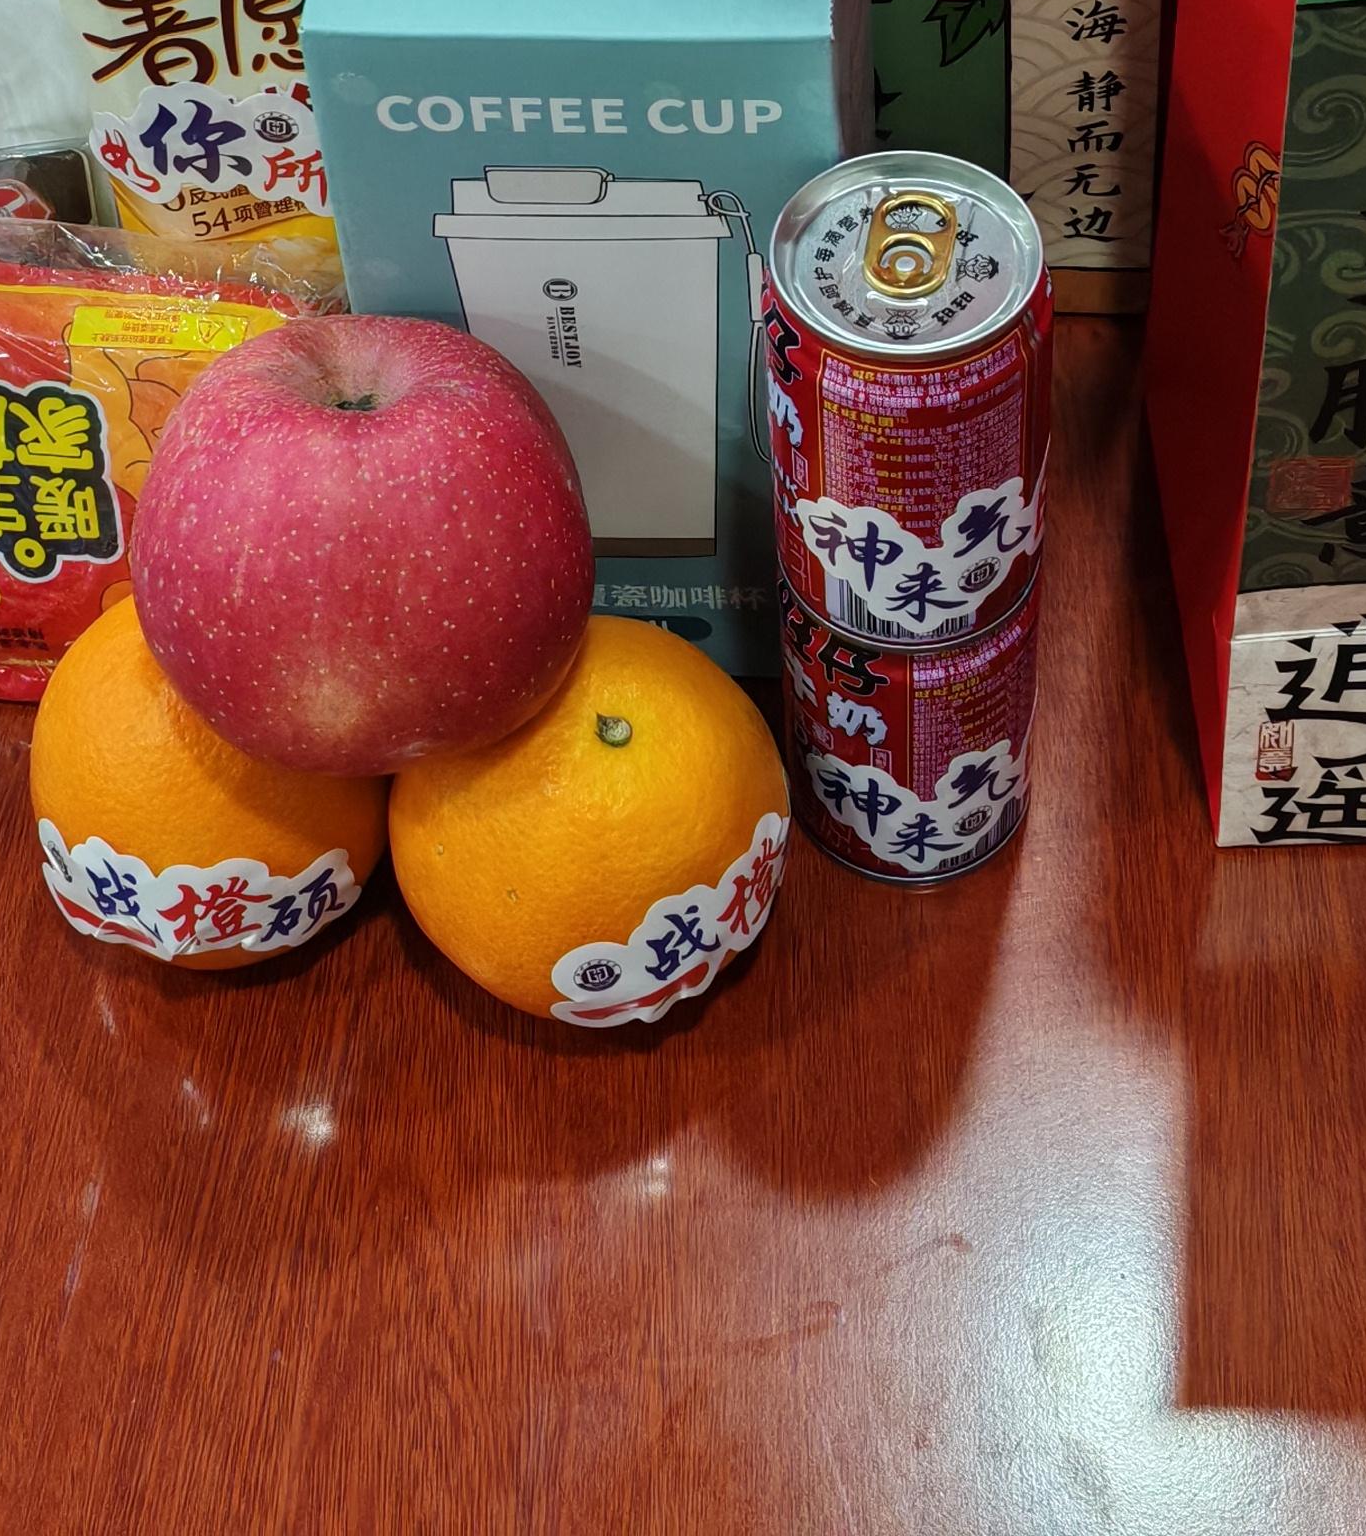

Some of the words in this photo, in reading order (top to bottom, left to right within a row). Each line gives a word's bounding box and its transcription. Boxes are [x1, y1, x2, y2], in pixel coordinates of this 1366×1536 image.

[377, 96, 628, 133] COFFEE
[647, 99, 783, 134] CUP
[559, 306, 583, 368] BESTJOY
